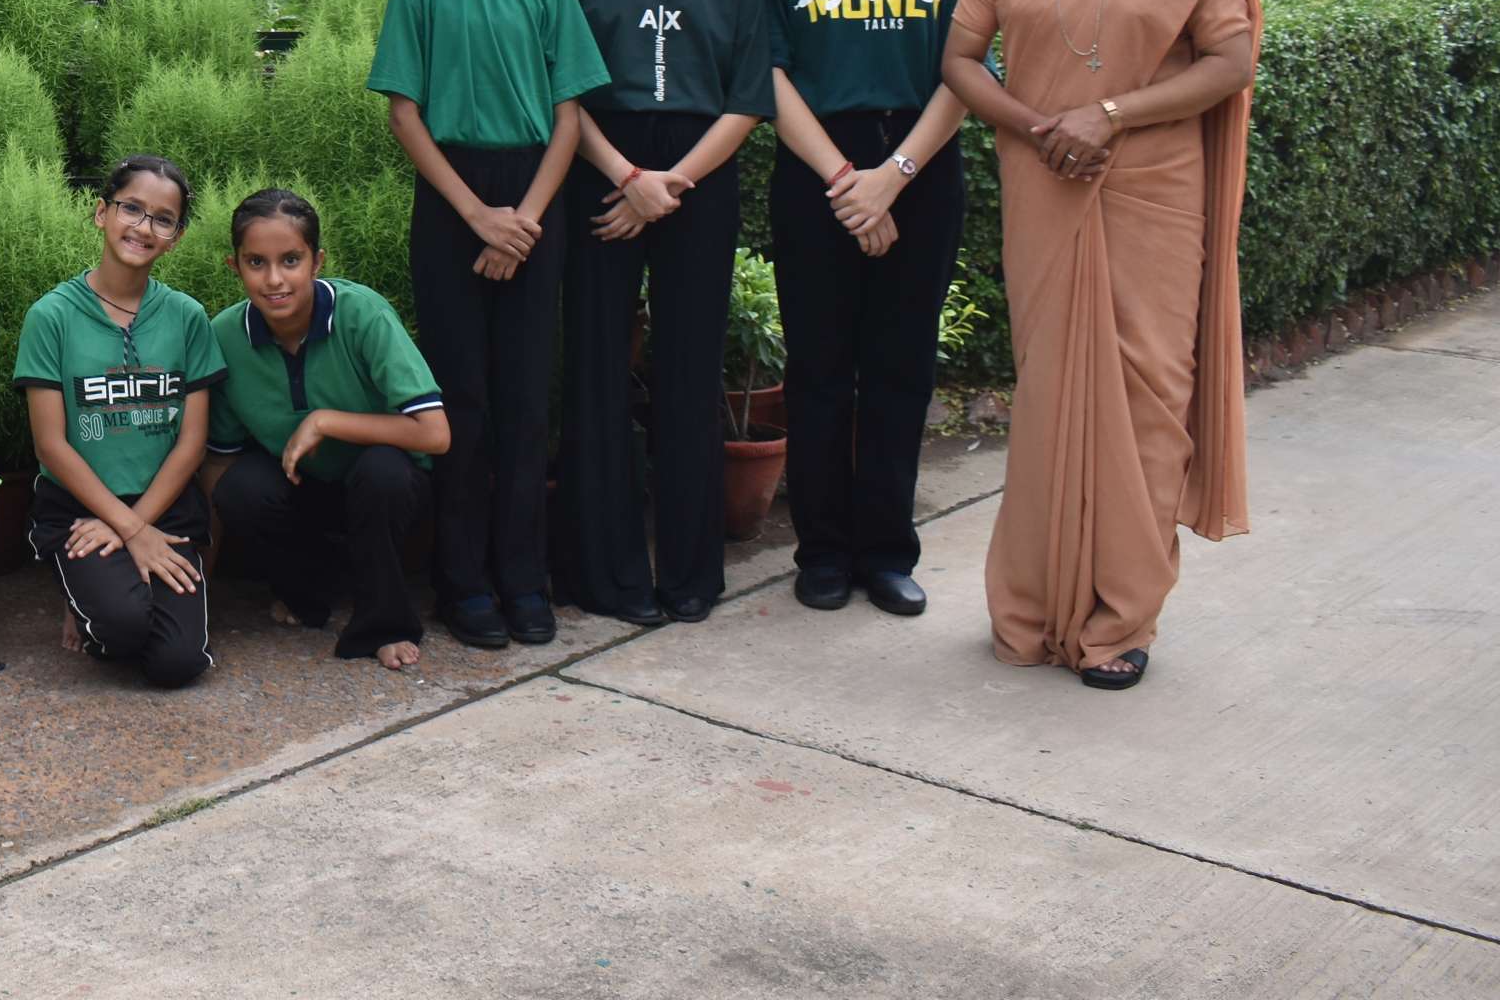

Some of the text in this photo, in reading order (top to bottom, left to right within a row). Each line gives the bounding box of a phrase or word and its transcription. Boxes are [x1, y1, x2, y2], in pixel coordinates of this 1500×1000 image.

[864, 19, 904, 30] TALKS
[655, 35, 667, 64] Armani
[83, 373, 181, 405] Spirit
